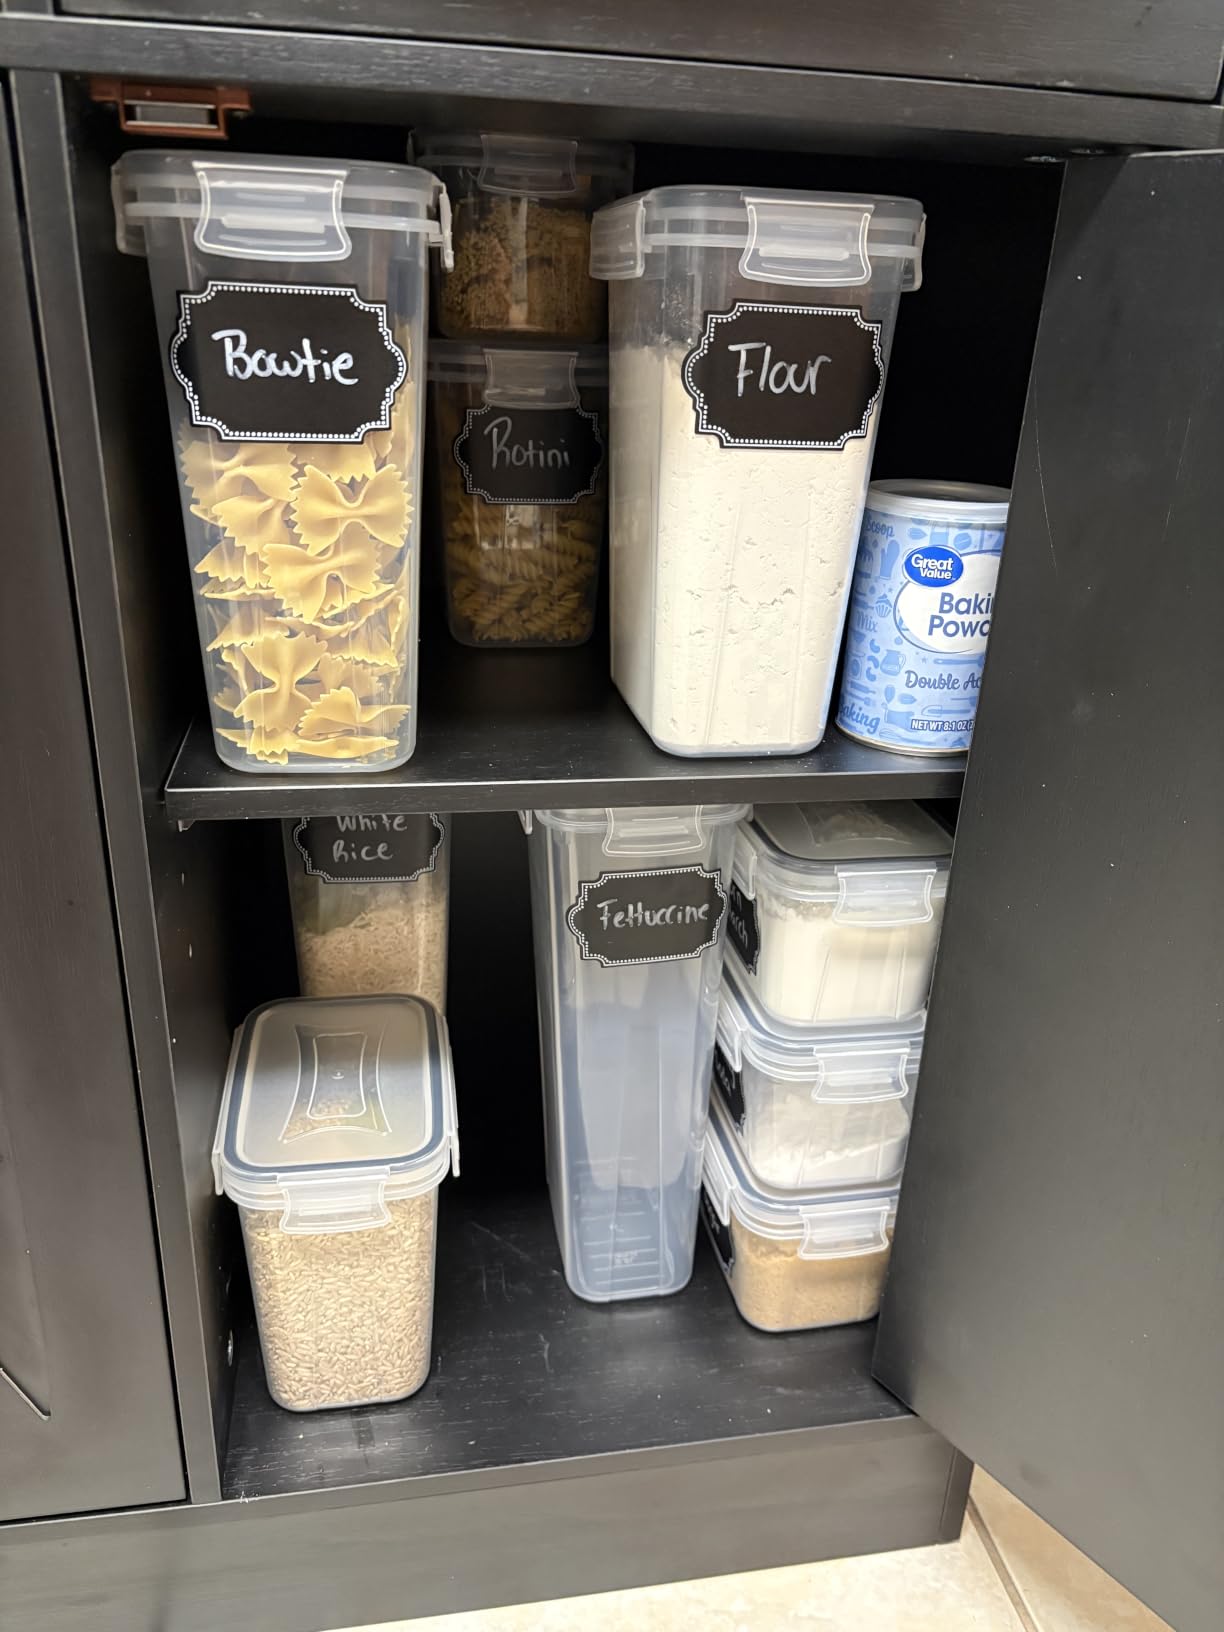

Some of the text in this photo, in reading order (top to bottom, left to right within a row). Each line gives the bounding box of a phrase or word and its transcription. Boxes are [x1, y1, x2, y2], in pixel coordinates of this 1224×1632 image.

[211, 329, 359, 385] Bowtie
[728, 342, 832, 397] Flour
[483, 416, 570, 470] Rotini
[911, 553, 953, 571] Great
[920, 568, 952, 579] Value
[938, 592, 993, 615] Baki
[904, 670, 960, 690] Double
[841, 702, 880, 735] aking
[912, 719, 928, 730] NET
[929, 720, 943, 731] WT
[943, 721, 956, 732] 8.1
[957, 721, 967, 730] OZ
[336, 813, 408, 833] White
[596, 898, 710, 931] Fettuccine
